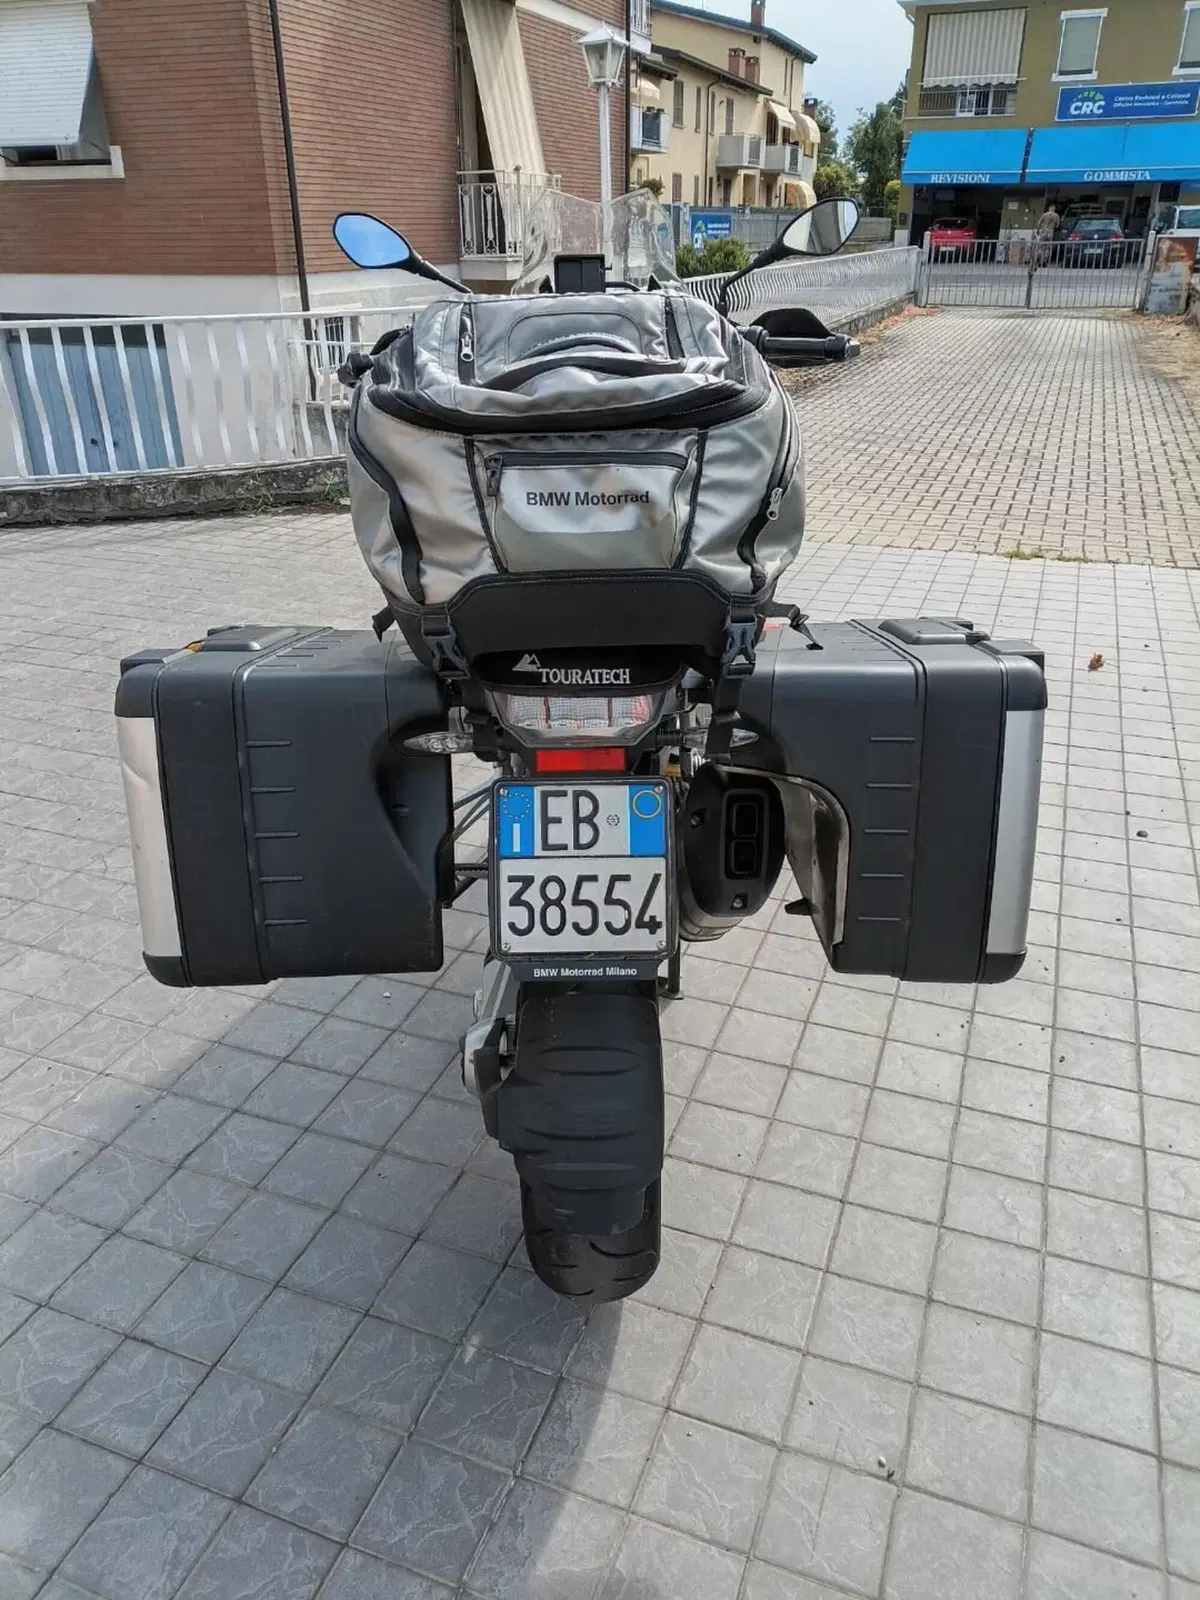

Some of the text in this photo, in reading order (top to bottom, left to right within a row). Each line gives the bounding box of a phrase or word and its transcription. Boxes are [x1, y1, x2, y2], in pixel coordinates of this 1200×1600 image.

[1069, 101, 1106, 115] CRC
[931, 173, 991, 184] REVISIONI
[1083, 170, 1151, 181] GOMMISTA
[526, 490, 650, 506] BMW Motorrad
[539, 668, 631, 684] TOURATECH
[540, 789, 600, 851] EB
[507, 873, 663, 937] 38554
[533, 966, 638, 978] BMW Motorrad Milano
